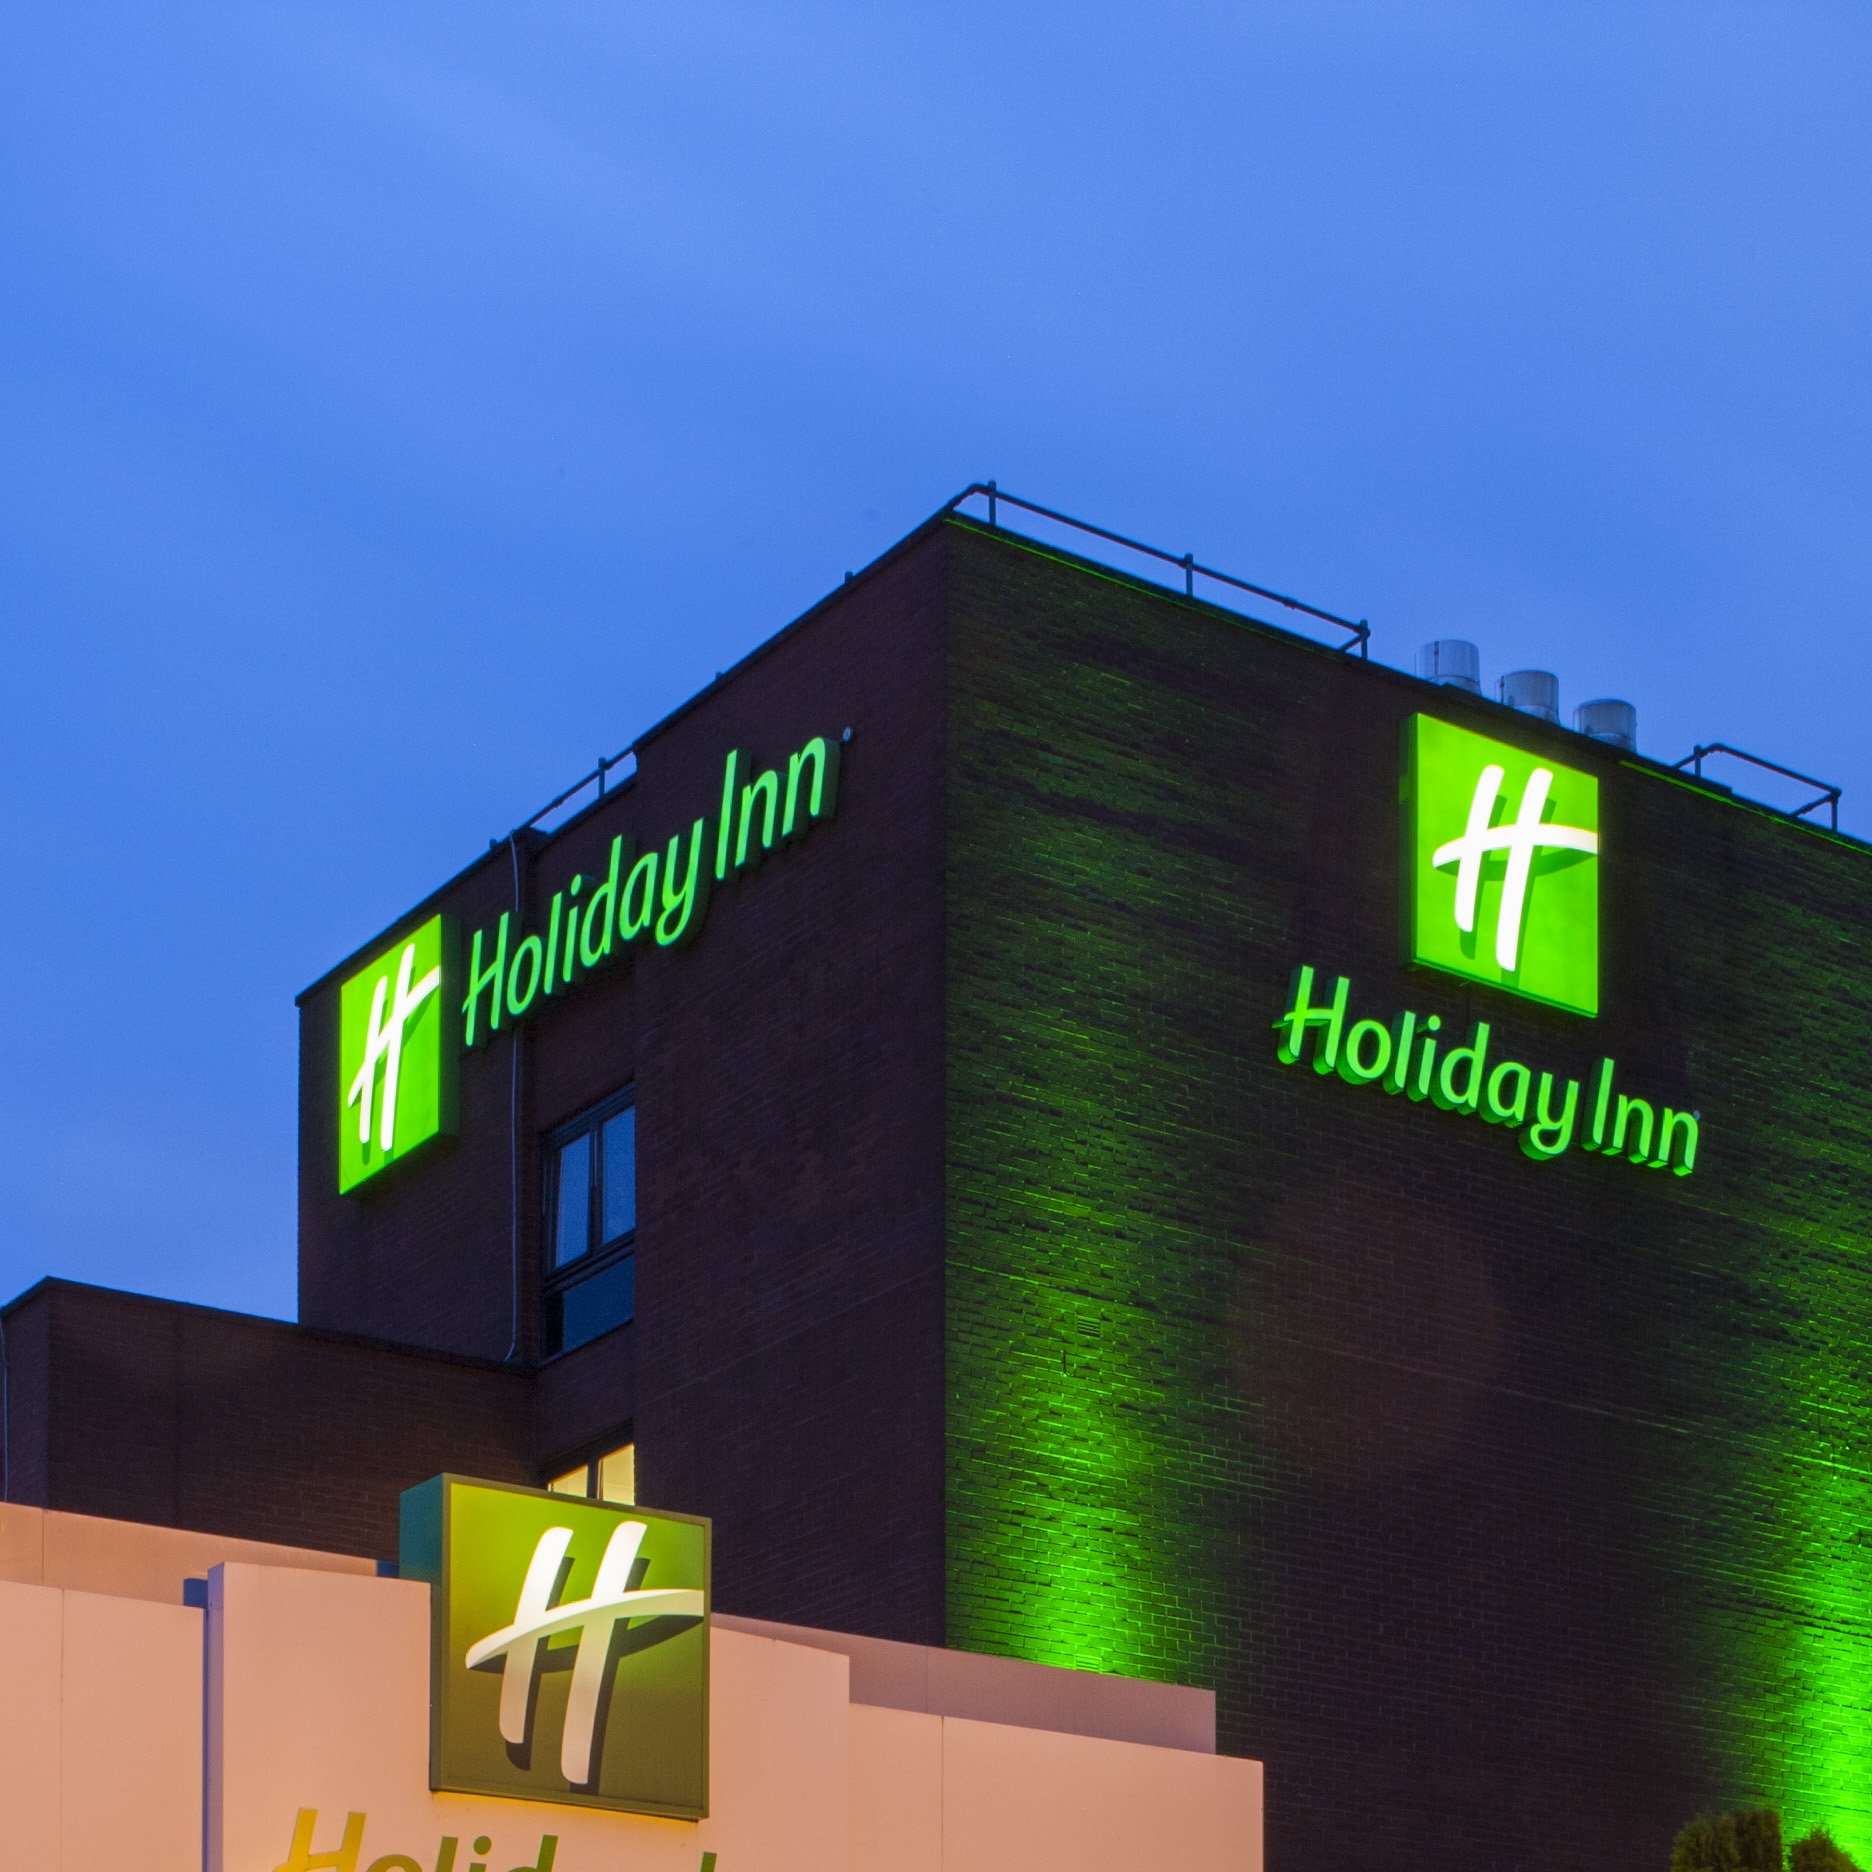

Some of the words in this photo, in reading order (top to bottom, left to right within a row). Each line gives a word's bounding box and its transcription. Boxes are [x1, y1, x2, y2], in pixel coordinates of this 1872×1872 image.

[462, 817, 704, 1047] Holiday
[715, 736, 828, 880] Inn
[1277, 964, 1580, 1158] Holiday
[1587, 1057, 1700, 1176] Inn
